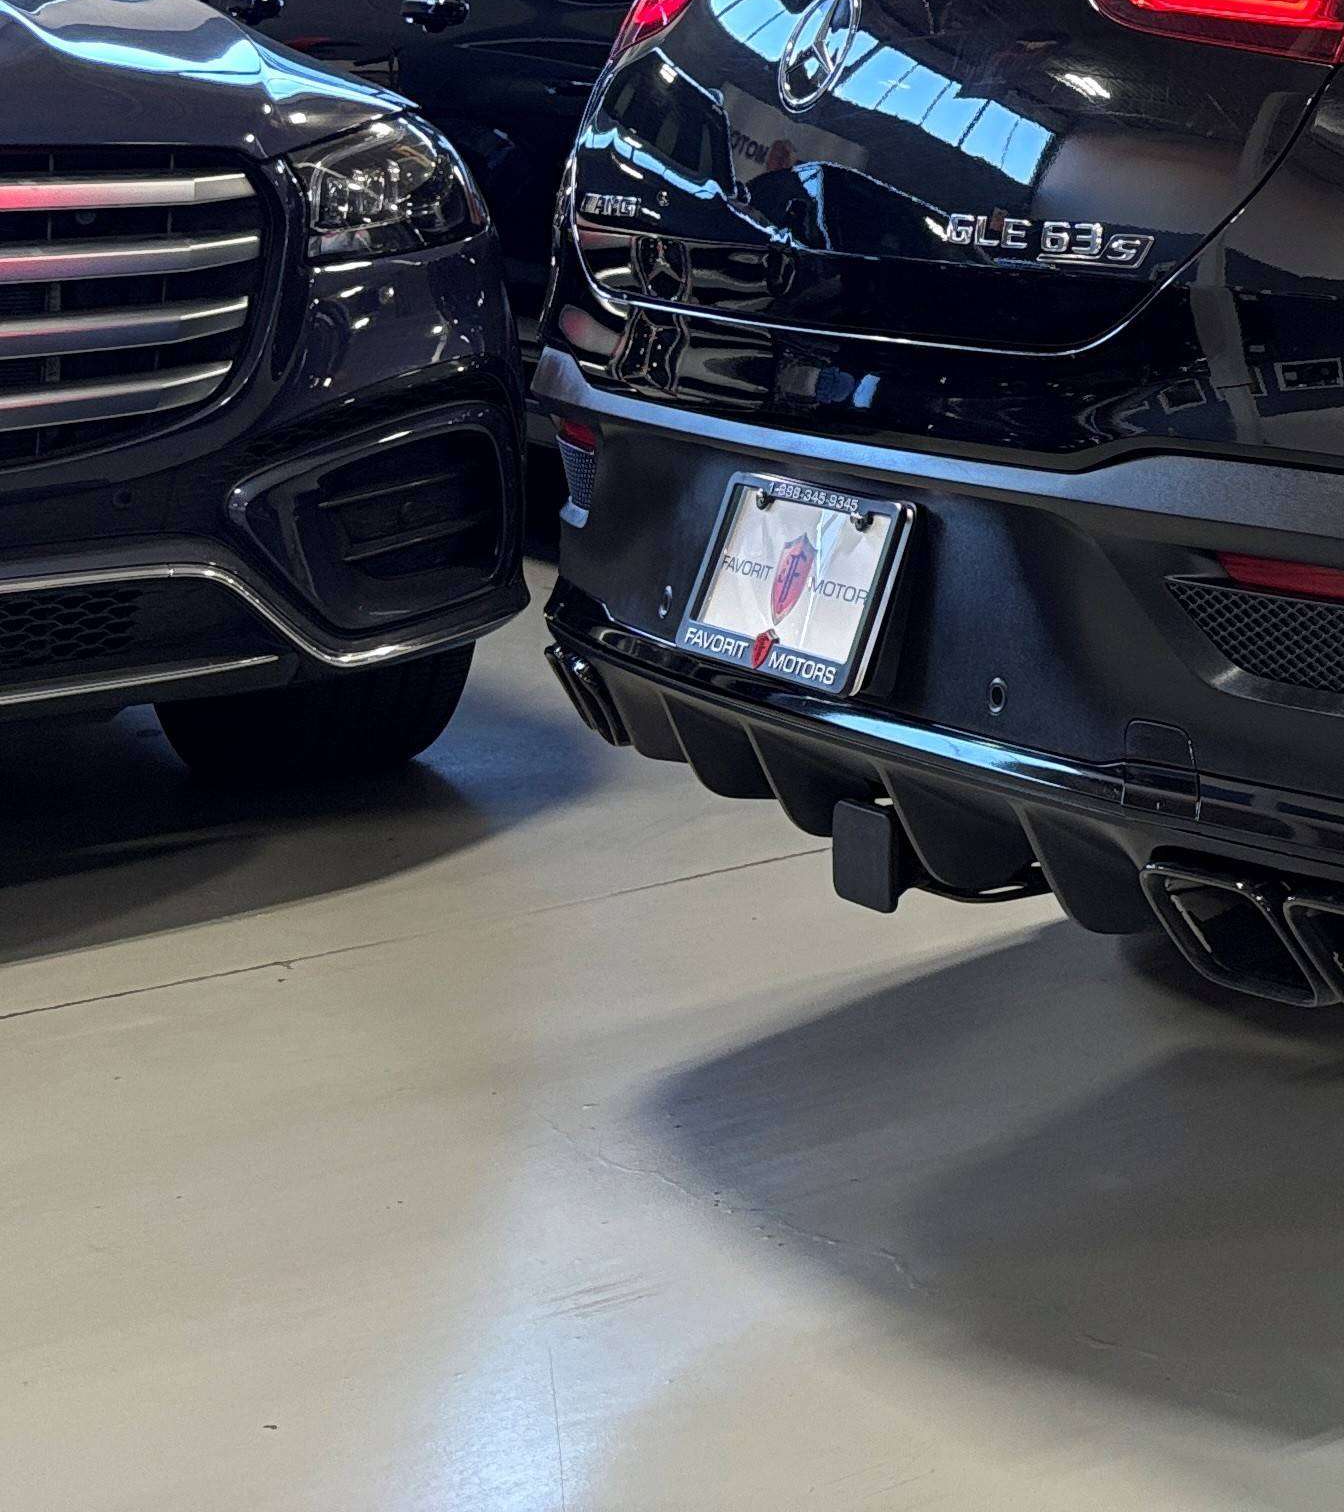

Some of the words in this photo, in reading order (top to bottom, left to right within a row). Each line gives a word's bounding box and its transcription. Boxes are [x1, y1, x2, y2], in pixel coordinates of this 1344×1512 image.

[946, 213, 1033, 250] GLE
[721, 553, 774, 582] FAVORIT
[810, 576, 869, 607] MOTOR
[684, 627, 749, 659] FAVORIT
[768, 650, 836, 685] MOTORS
